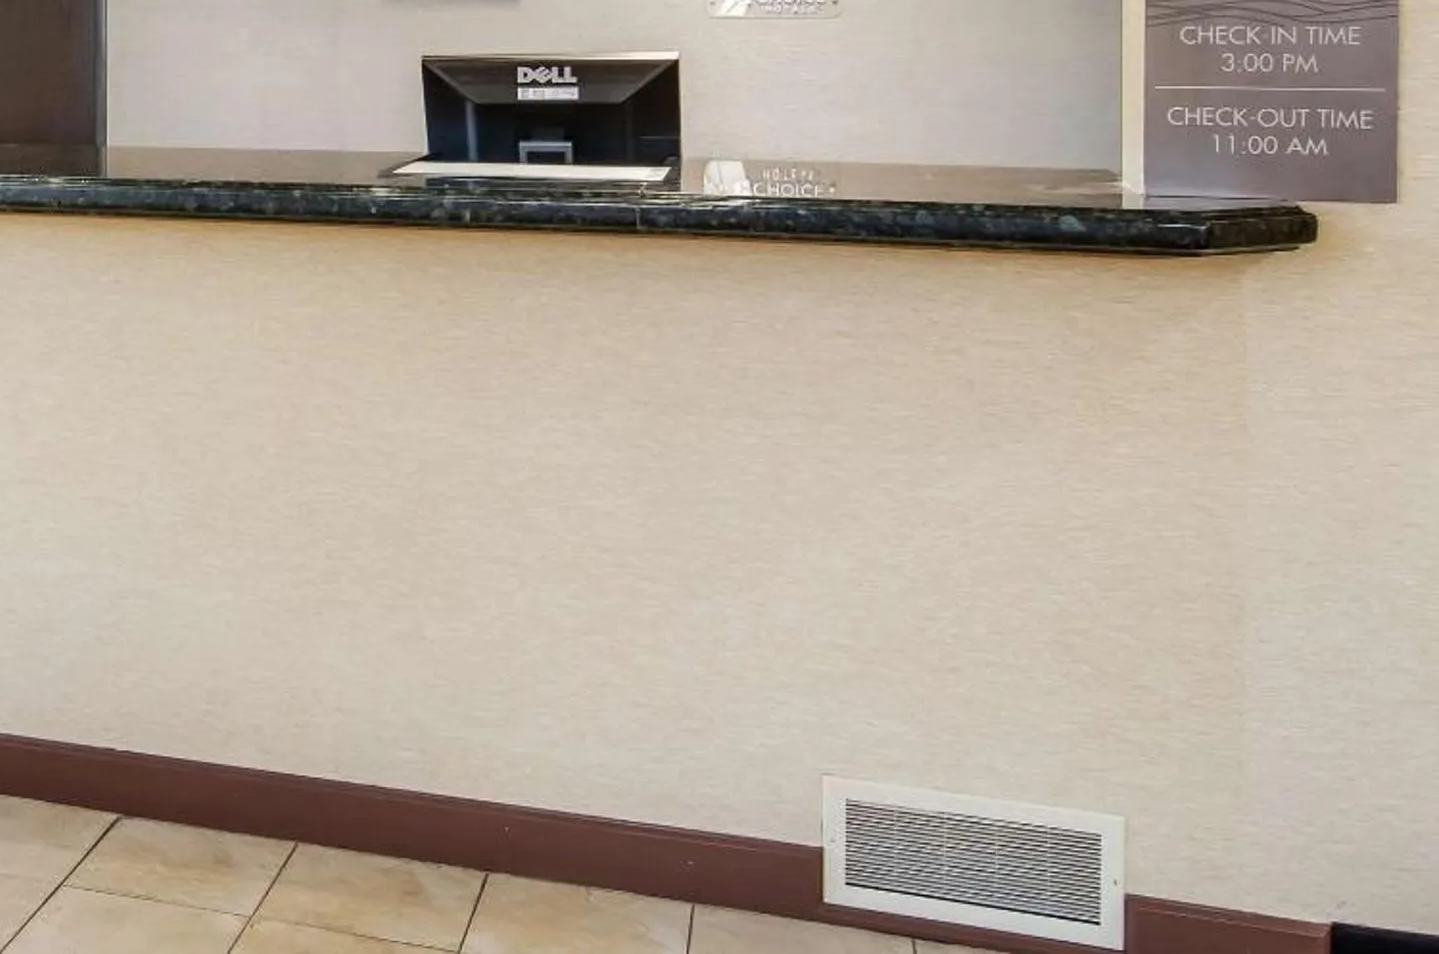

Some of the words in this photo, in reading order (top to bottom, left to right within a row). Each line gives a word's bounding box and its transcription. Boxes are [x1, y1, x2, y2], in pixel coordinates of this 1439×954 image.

[1305, 26, 1362, 45] TIME
[1220, 52, 1274, 74] 3:00
[1282, 54, 1320, 73] PM
[517, 66, 578, 84] DELL
[1167, 107, 1309, 128] CHECK-OUT
[1317, 108, 1375, 129] TIME
[1213, 134, 1279, 155] 11:00
[1285, 136, 1329, 155] AM
